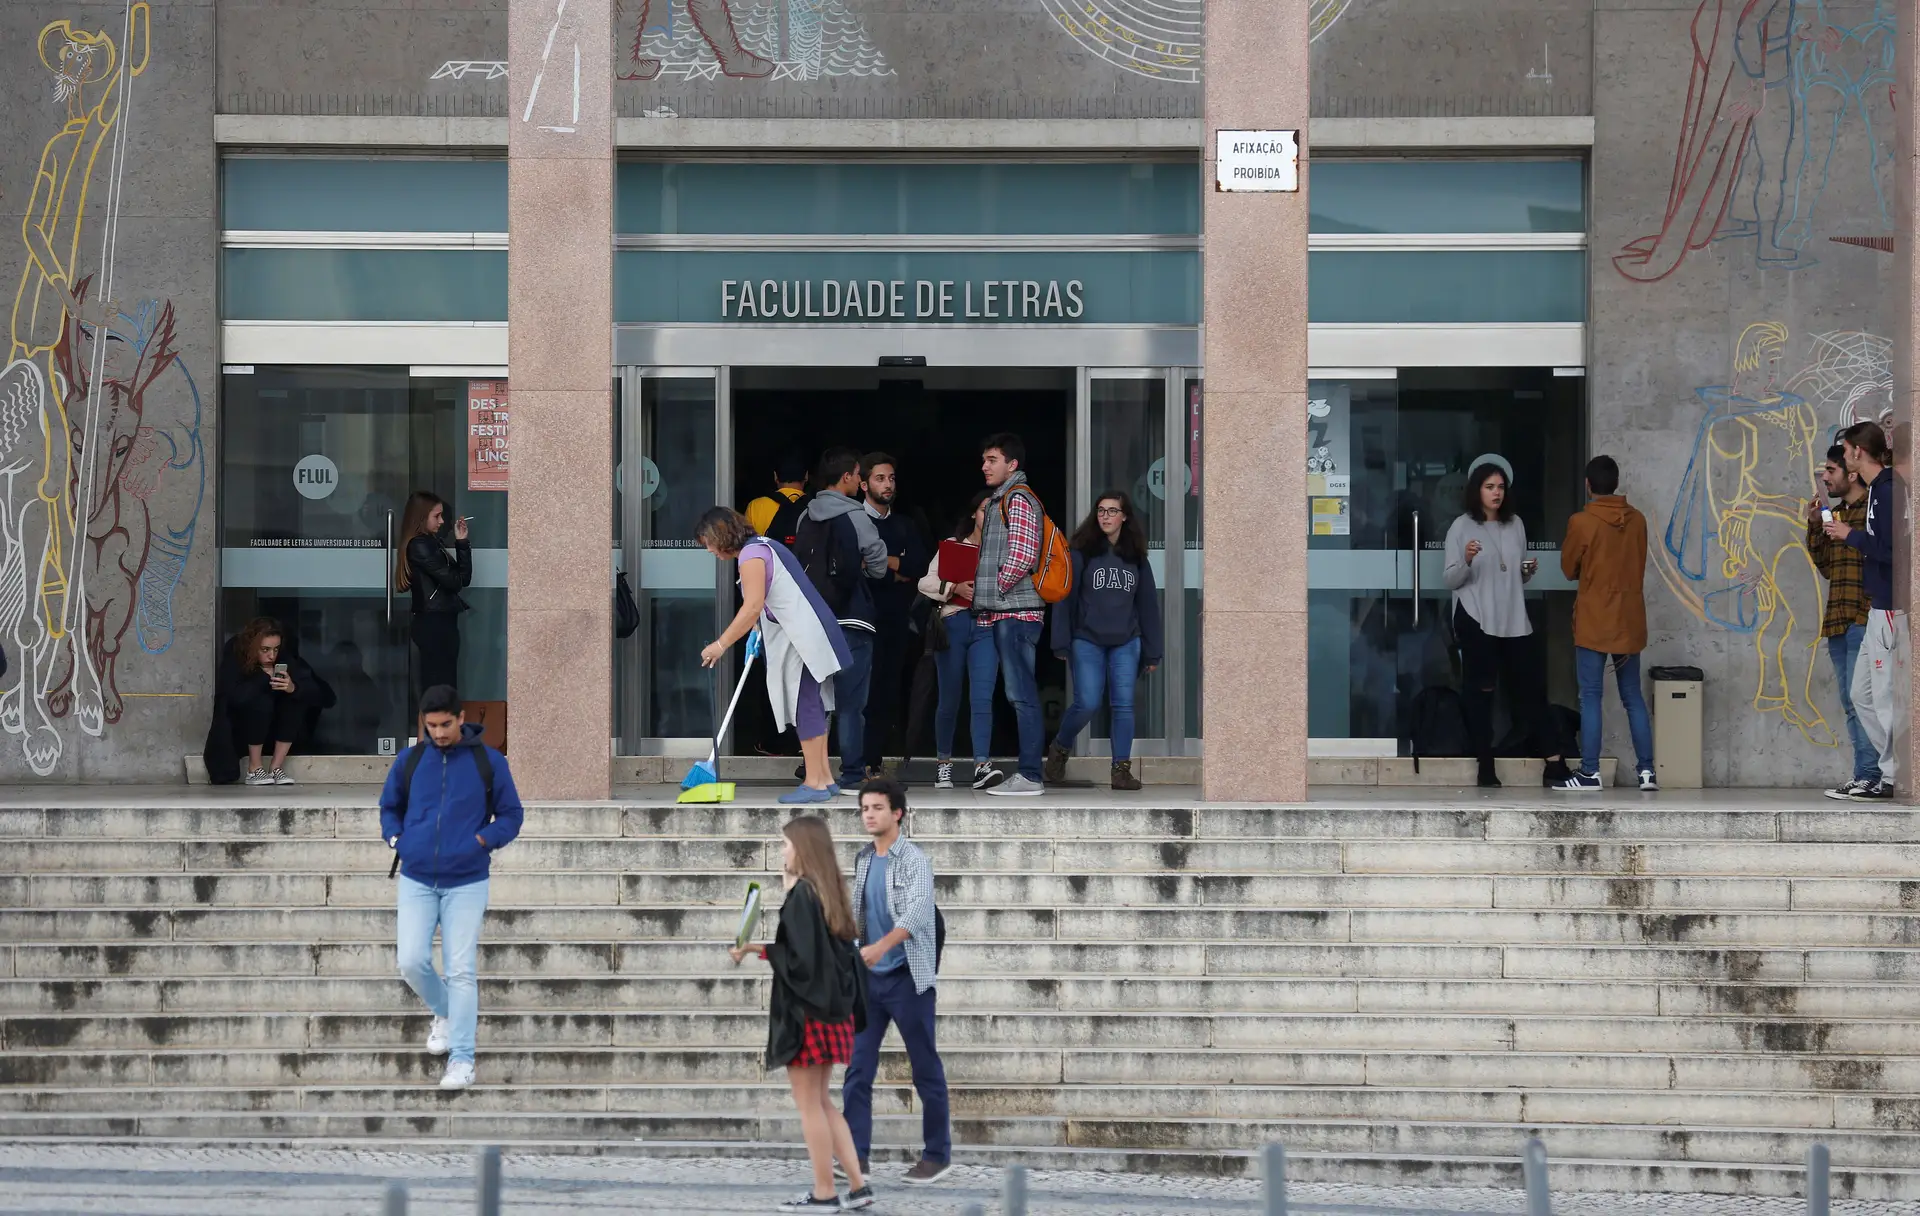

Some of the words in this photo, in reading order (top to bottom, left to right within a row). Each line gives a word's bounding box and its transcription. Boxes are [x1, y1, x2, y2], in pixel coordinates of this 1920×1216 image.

[1233, 167, 1281, 179] PROIBIDA
[721, 279, 905, 318] FACULDADE
[916, 280, 955, 318] DE
[965, 279, 1085, 318] LETRAS
[470, 398, 497, 410] DES
[493, 412, 509, 421] TR
[470, 424, 509, 436] FESTI
[478, 447, 509, 462] LÍNG
[298, 468, 333, 485] FLUL
[250, 539, 282, 547] FACULDADE
[283, 539, 291, 547] DE
[291, 539, 313, 547] LETRAS
[313, 539, 353, 547] UNIVERSIDADE
[353, 539, 361, 547] DE
[361, 539, 382, 547] LISBOA
[674, 539, 682, 548] DE
[1527, 541, 1536, 549] DE
[1536, 541, 1557, 549] LISBOA
[1093, 567, 1136, 592] GAP
